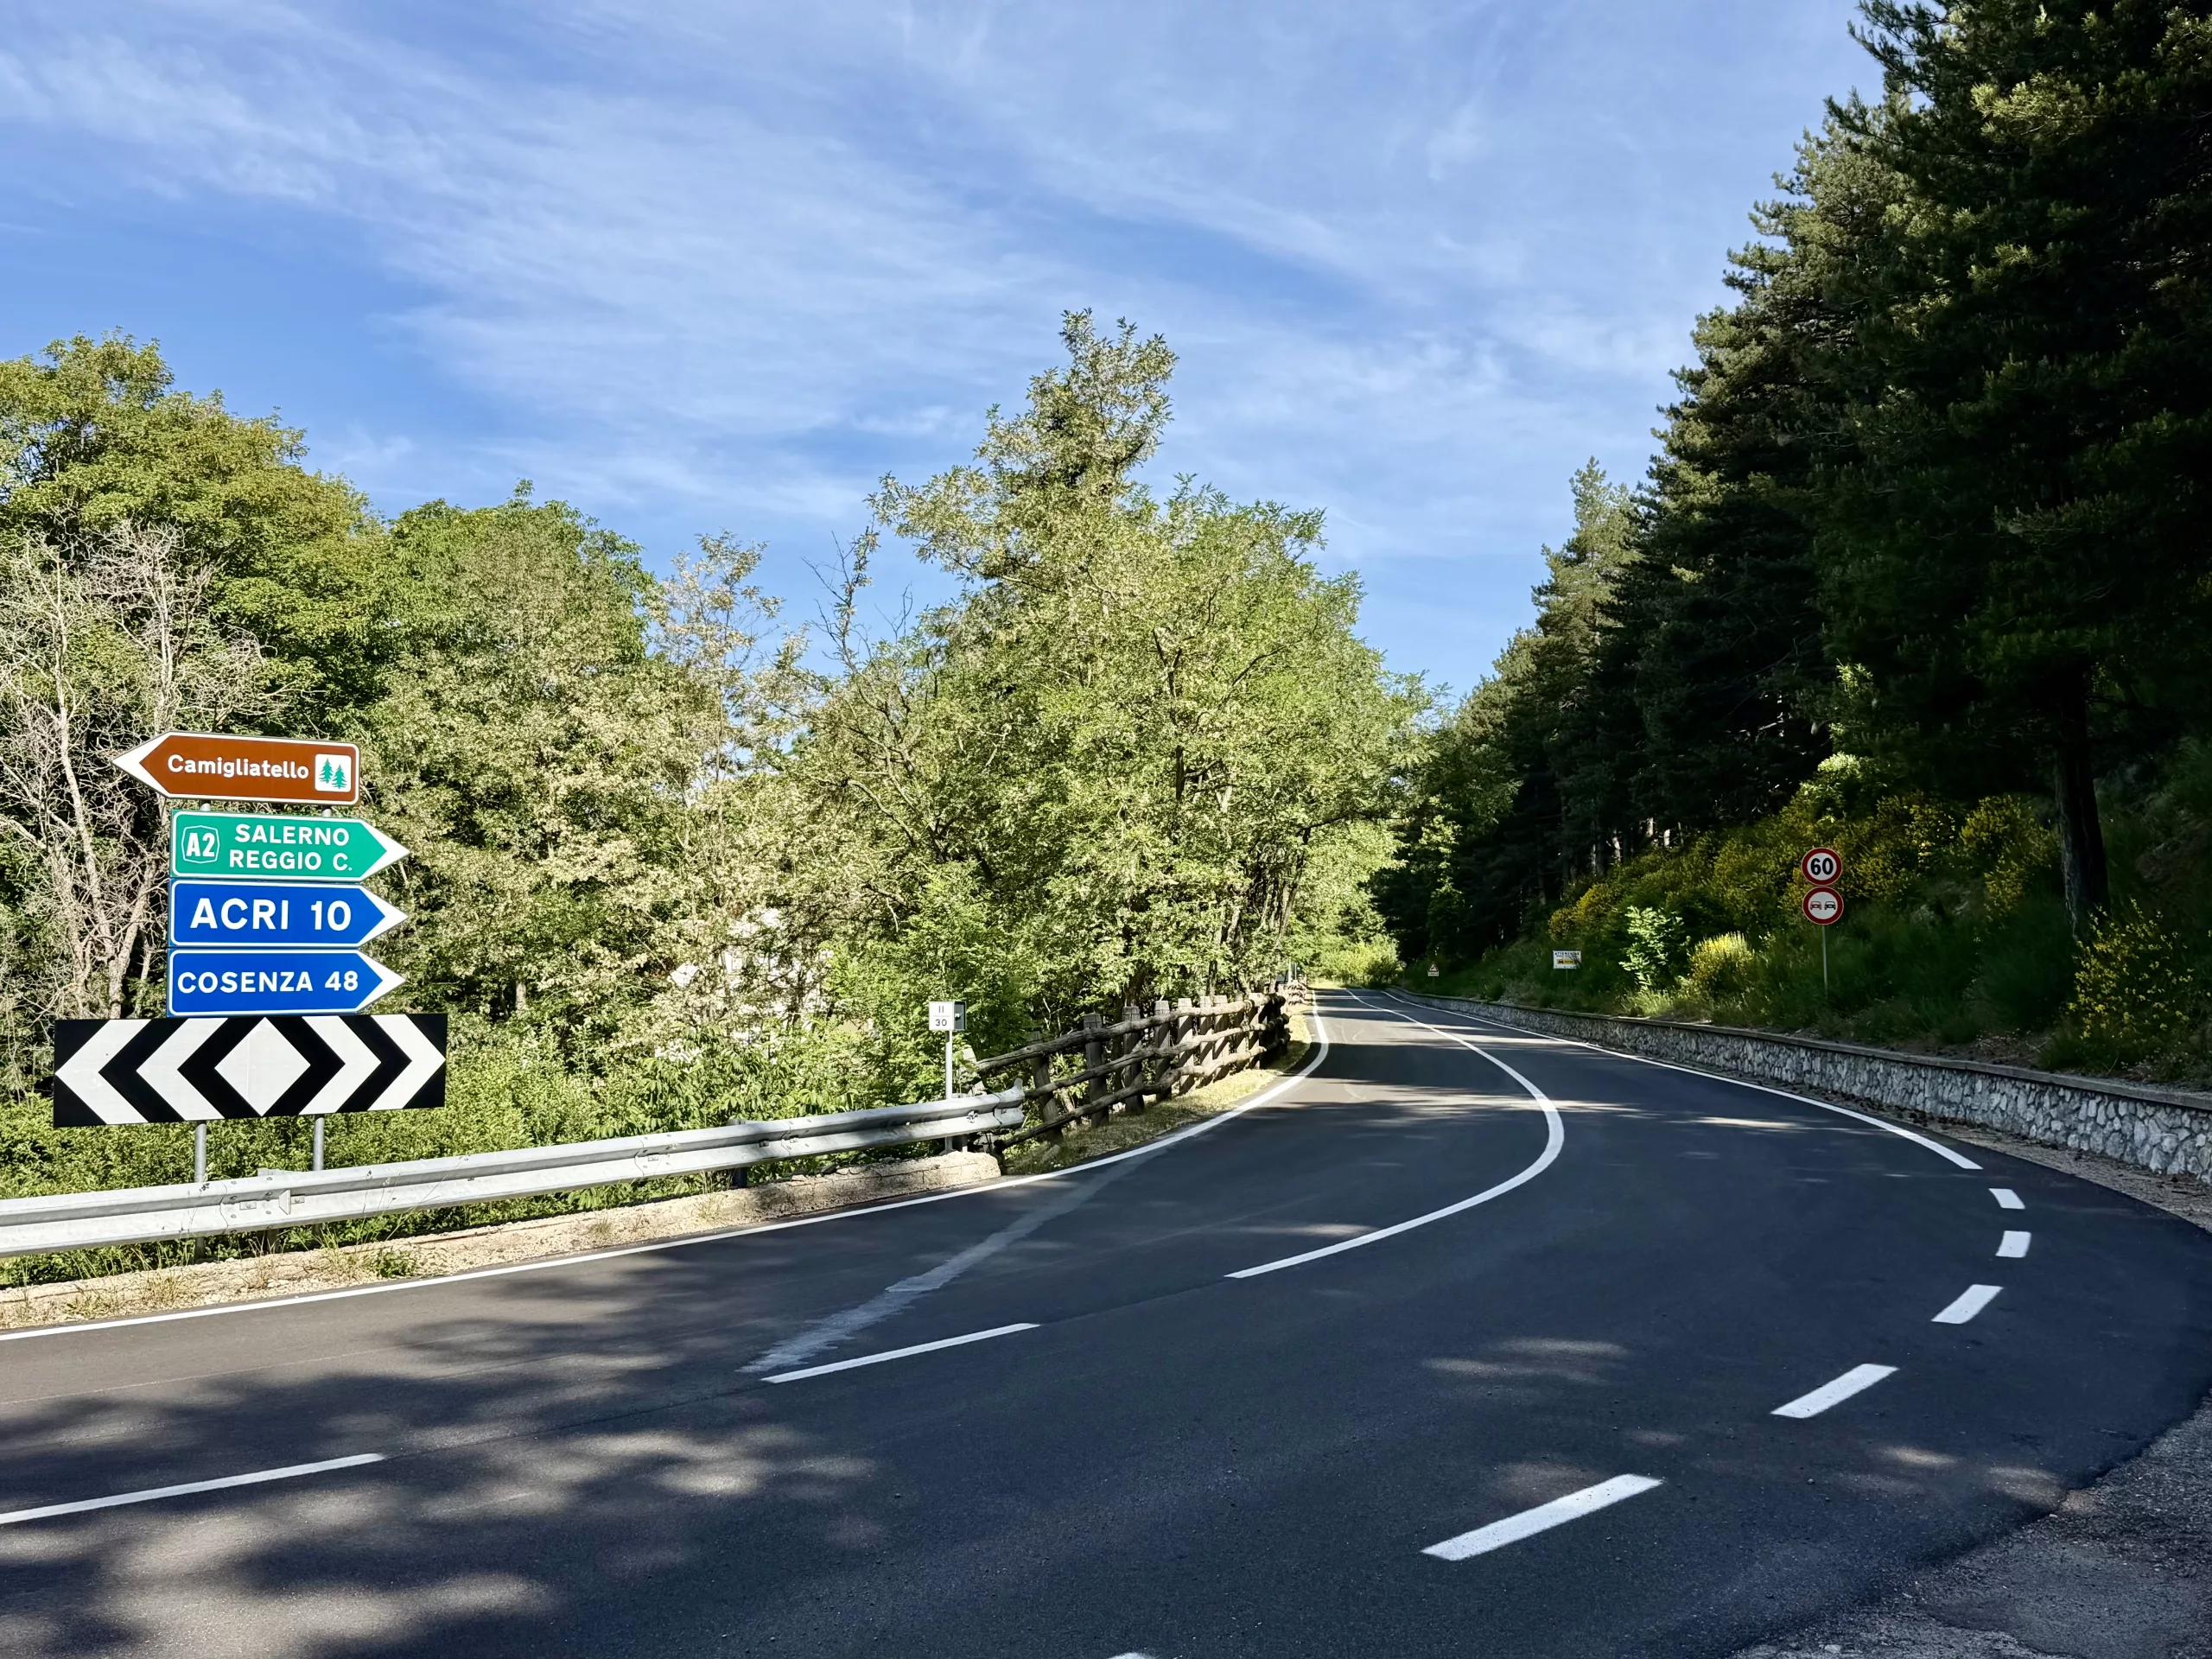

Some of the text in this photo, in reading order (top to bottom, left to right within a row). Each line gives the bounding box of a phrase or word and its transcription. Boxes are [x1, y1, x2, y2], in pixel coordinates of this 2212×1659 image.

[168, 754, 309, 779] Camigliatello
[186, 832, 215, 857] A2
[234, 823, 350, 847] SALERNO
[229, 849, 353, 872] REGGIO C.
[1810, 857, 1834, 875] 60
[190, 898, 352, 931] ACRI 10
[177, 970, 359, 994] COSENZA 48
